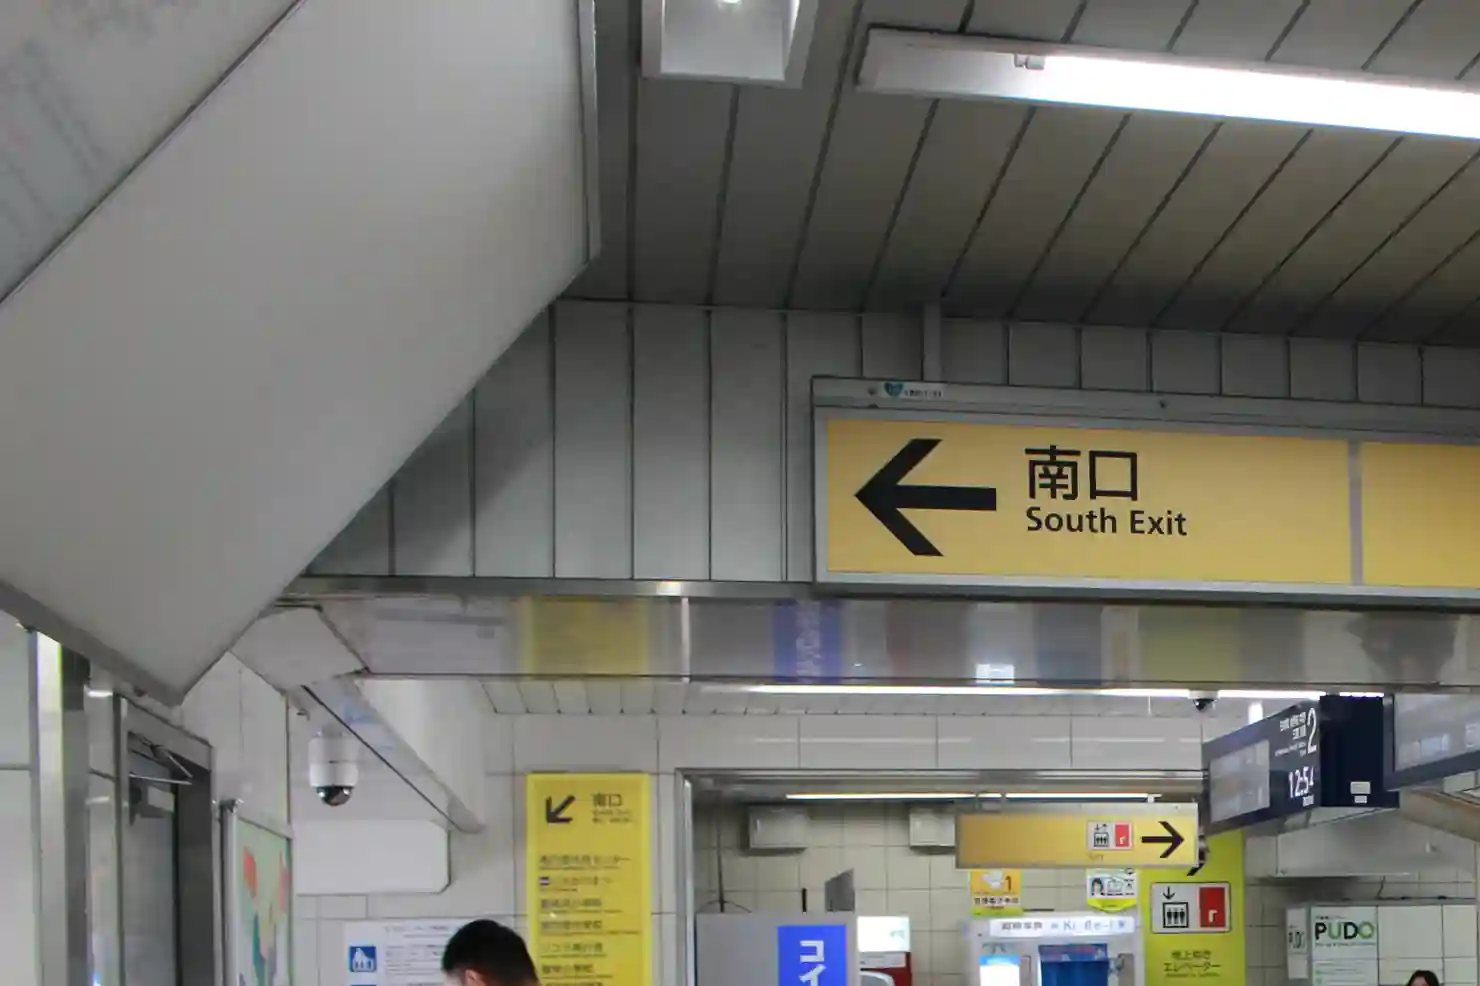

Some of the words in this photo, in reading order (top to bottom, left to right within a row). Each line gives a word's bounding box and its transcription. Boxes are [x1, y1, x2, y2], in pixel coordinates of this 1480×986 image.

[1025, 444, 1139, 501] 南口
[1026, 506, 1118, 535] South
[1130, 509, 1188, 537] Exit
[1314, 920, 1375, 940] PUDO
